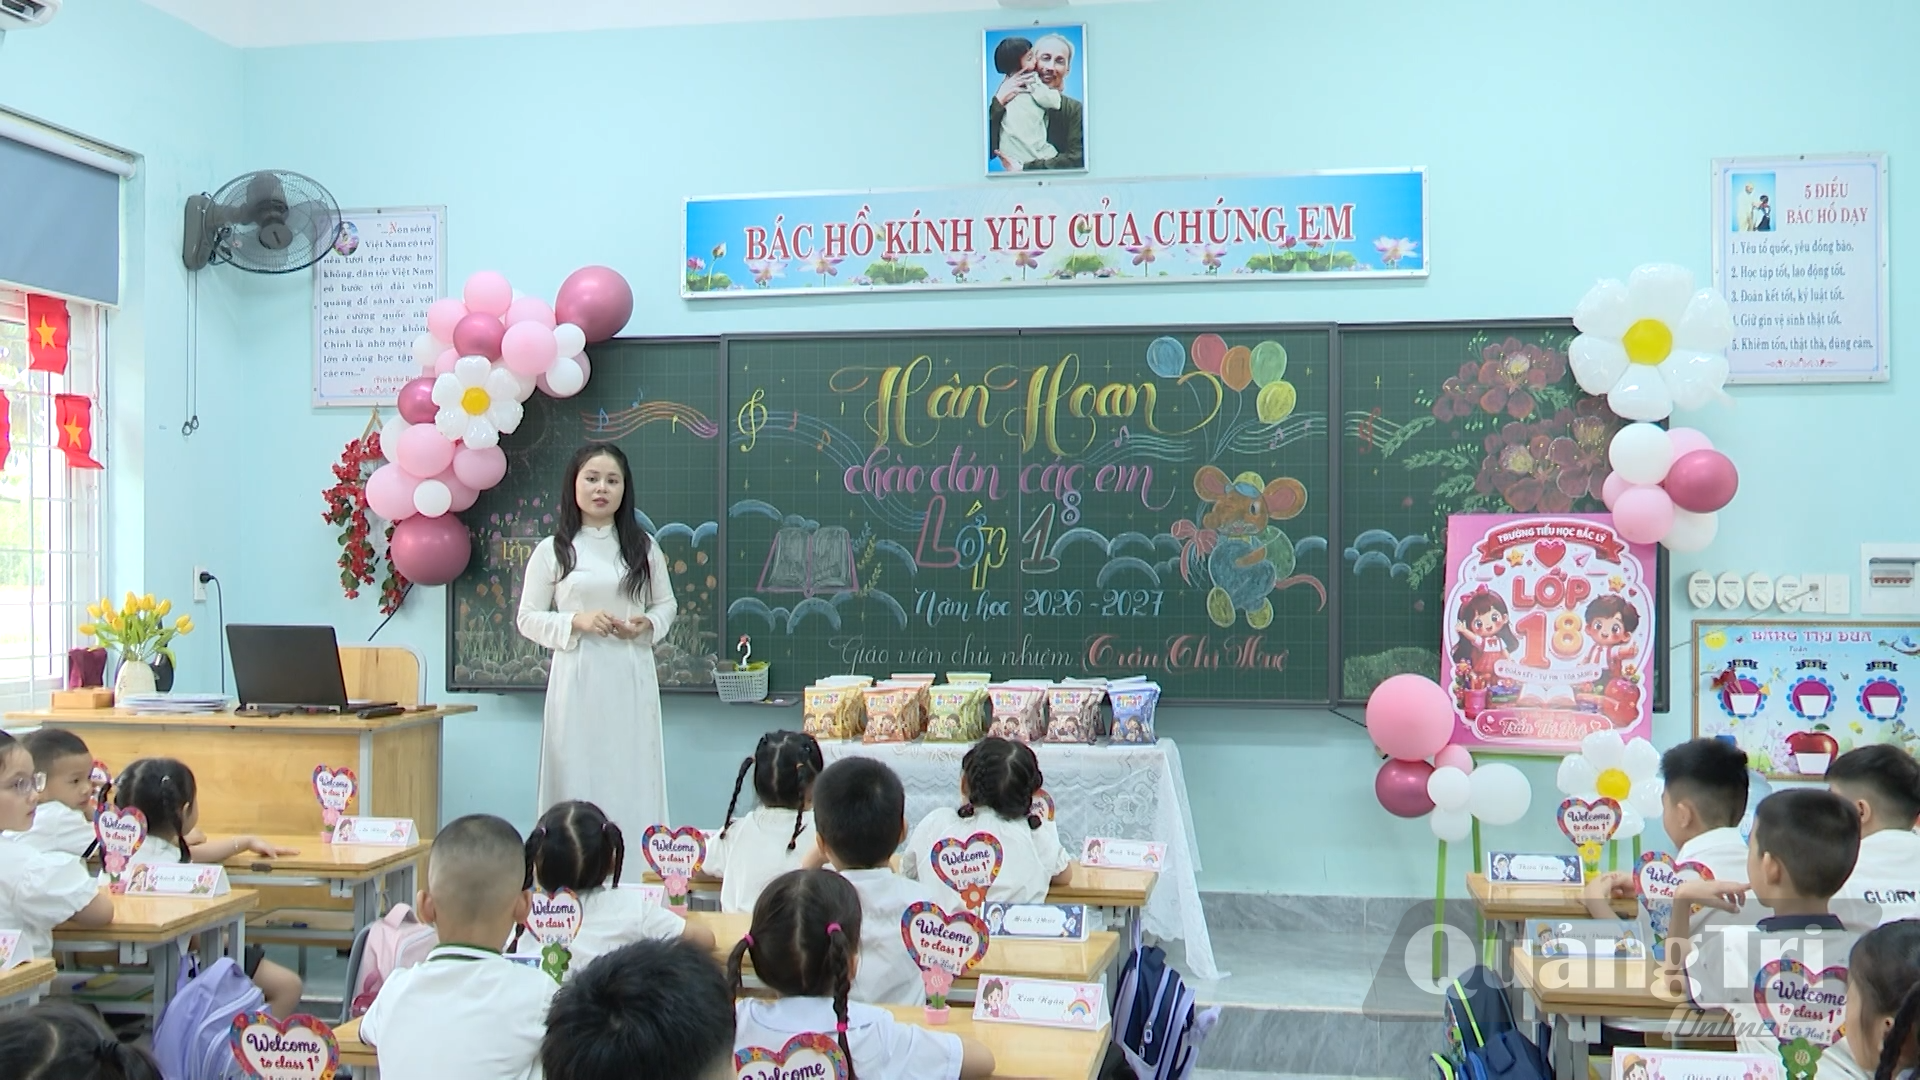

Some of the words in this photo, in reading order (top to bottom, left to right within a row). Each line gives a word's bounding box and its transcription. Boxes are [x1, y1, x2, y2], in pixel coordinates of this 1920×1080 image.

[1804, 185, 1812, 199] 5
[1786, 205, 1814, 224] BÁC
[746, 215, 812, 260] BÁC
[824, 205, 874, 257] HỒ
[885, 209, 973, 255] KÍNH
[984, 205, 1056, 251] YÊU
[1068, 197, 1143, 248] CỦA
[1153, 197, 1287, 245] CHÚNG
[1298, 204, 1354, 240] EM
[830, 355, 1000, 449] Hân
[984, 353, 1223, 458] Hoan
[843, 445, 927, 501] chào
[930, 444, 1008, 501] đón
[1019, 455, 1086, 499] các
[1093, 463, 1176, 511] em
[915, 494, 1009, 592] Lớp
[1497, 526, 1536, 544] TRƯỜNG
[1556, 527, 1575, 538] HỌC
[1511, 565, 1592, 612] LỚP
[914, 586, 971, 628] Năm
[976, 589, 1011, 622] học
[1023, 588, 1083, 617] 2026
[1101, 588, 1165, 617] 2027
[1516, 610, 1584, 669] 18
[828, 633, 889, 676] Giáo
[897, 643, 945, 665] viên
[951, 632, 993, 666] chủ
[102, 816, 138, 833] Welcome
[1567, 811, 1611, 822] Welcome
[652, 839, 696, 852] Welcome
[942, 850, 990, 866] Welcome
[1649, 884, 1658, 893] to
[1863, 890, 1917, 904] GLORY
[916, 917, 974, 946] Welcome
[920, 937, 930, 948] to
[931, 940, 955, 956] class
[1772, 980, 1848, 1006] Welcome
[1779, 1003, 1791, 1016] to
[1793, 1004, 1823, 1020] class
[246, 1033, 321, 1054] Welcome
[259, 1055, 273, 1069] to
[275, 1055, 305, 1070] class
